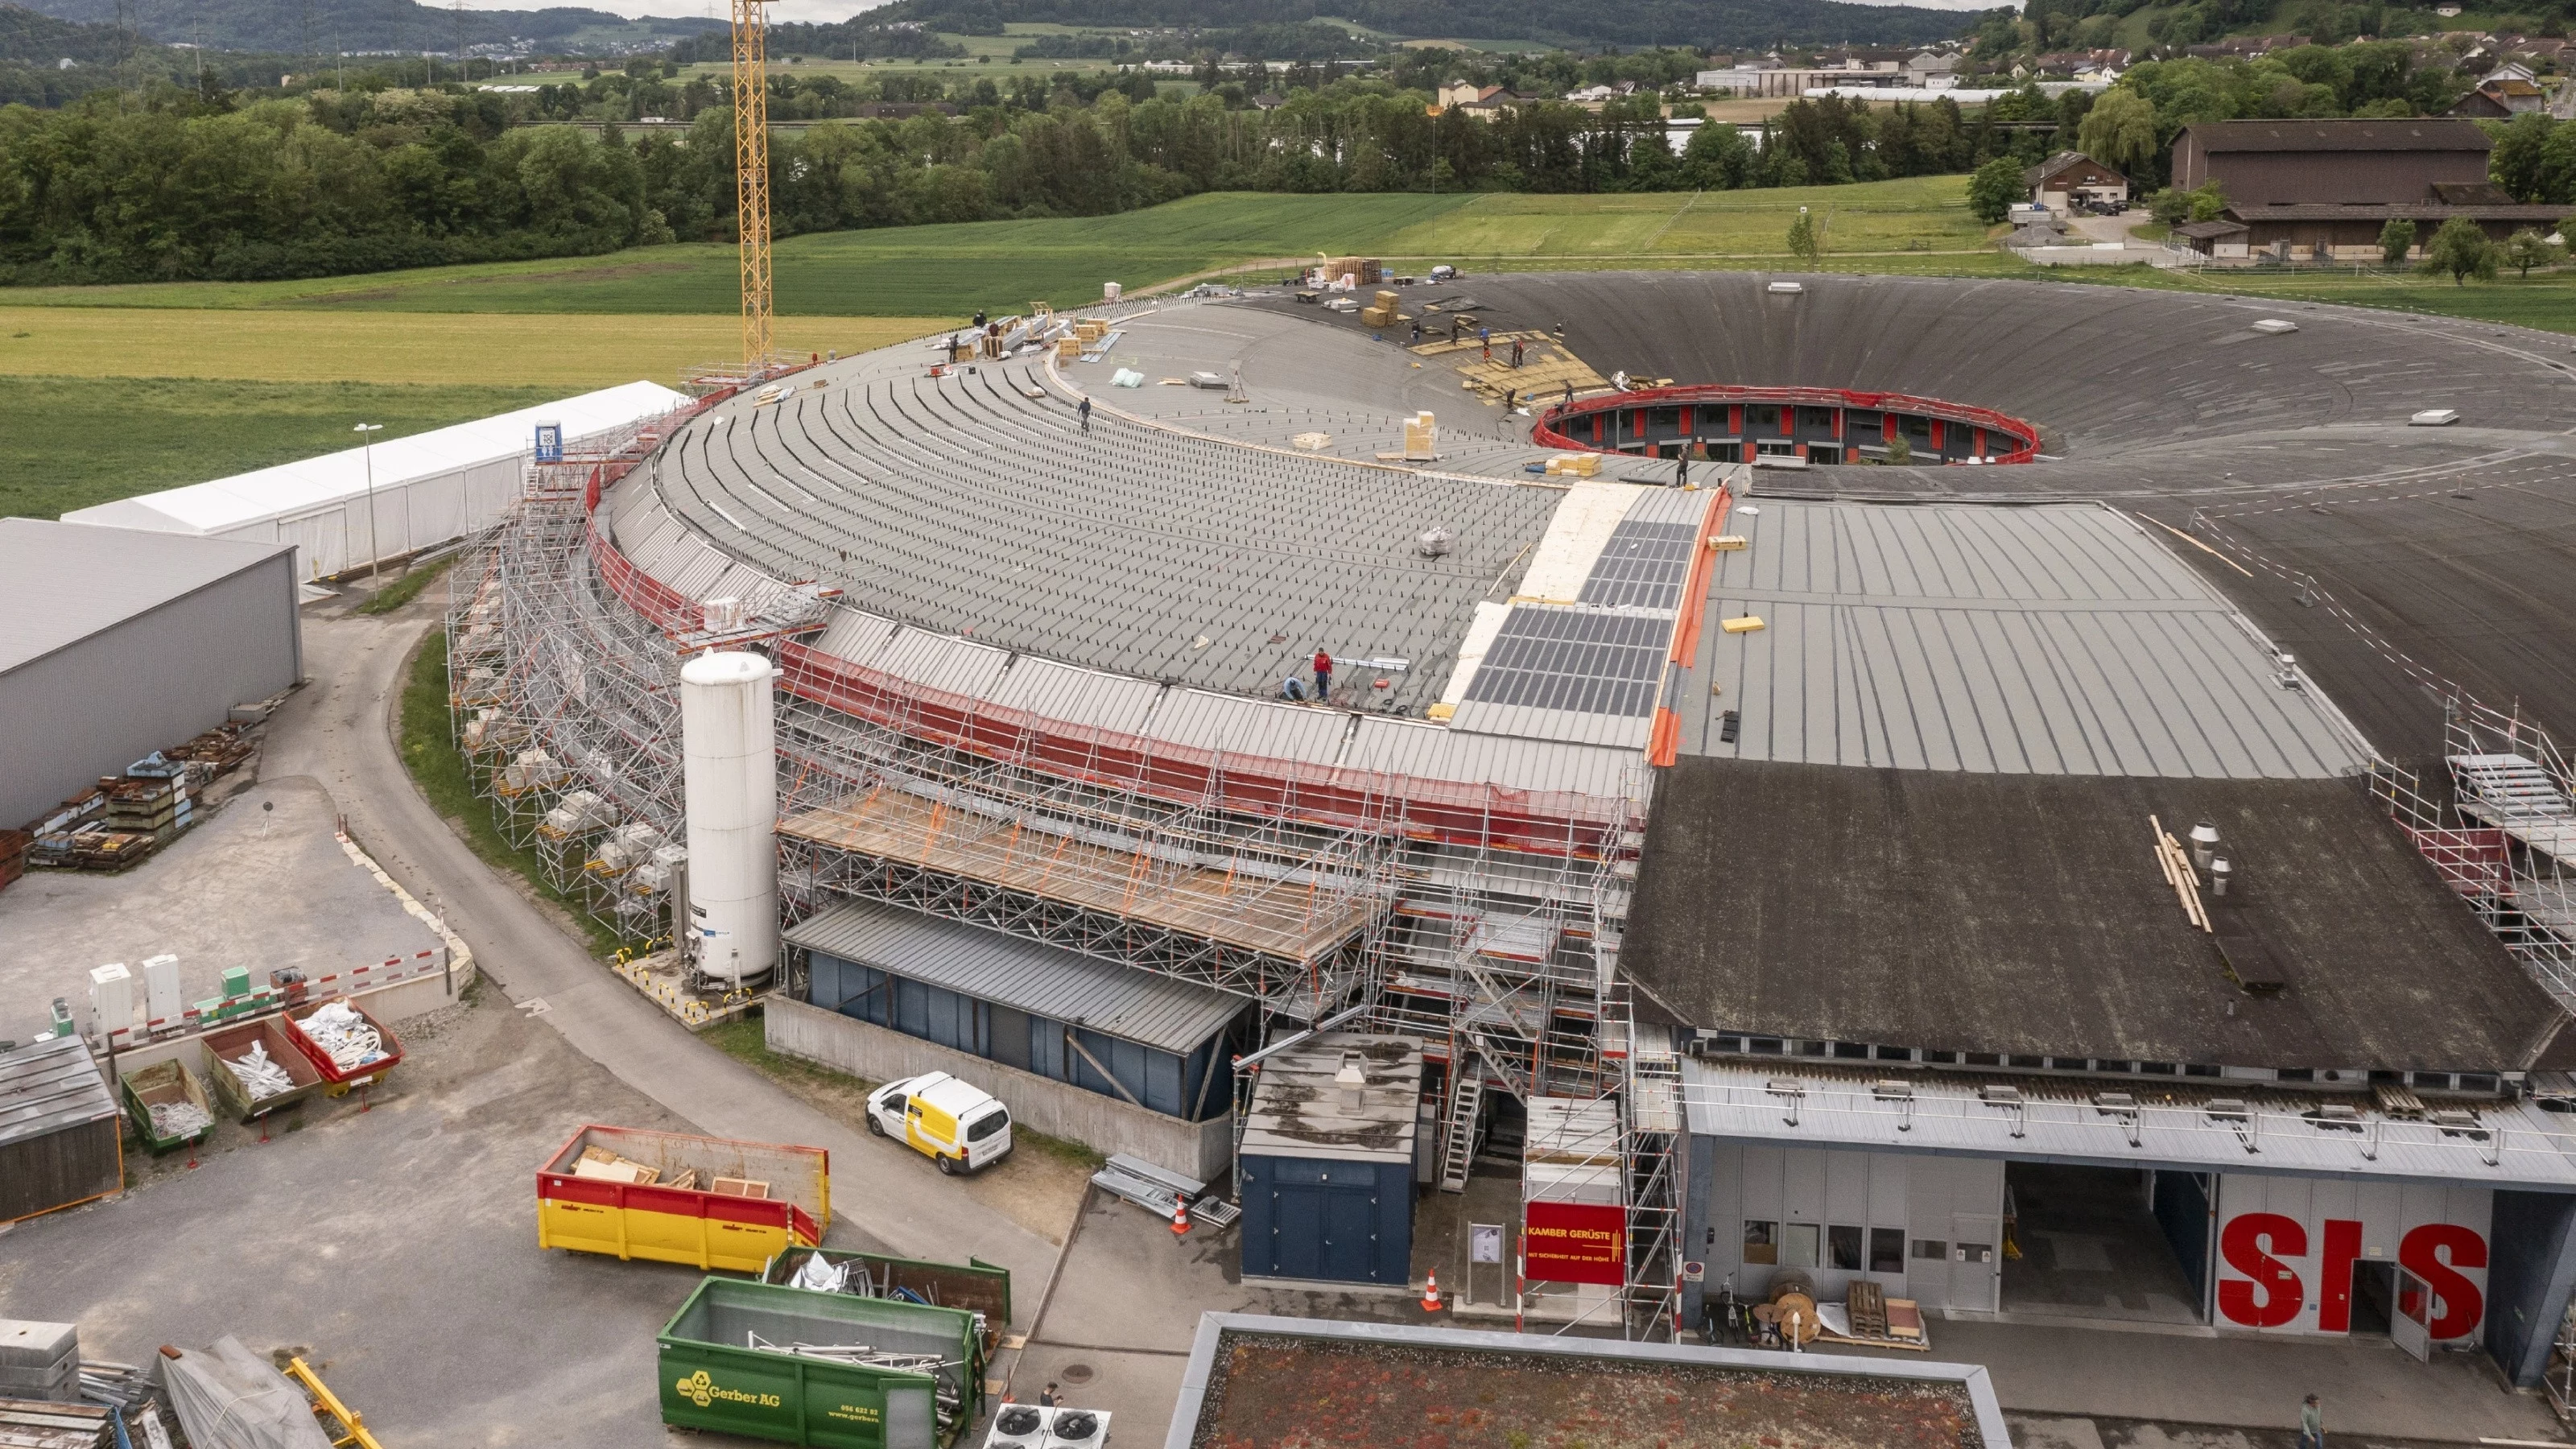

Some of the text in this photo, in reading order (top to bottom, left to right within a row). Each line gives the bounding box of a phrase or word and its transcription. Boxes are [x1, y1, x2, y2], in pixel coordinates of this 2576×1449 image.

[1528, 1227, 1610, 1240] KAMBER GERÜSTE
[2218, 1212, 2488, 1340] SIS
[708, 1385, 780, 1407] Gerber AG
